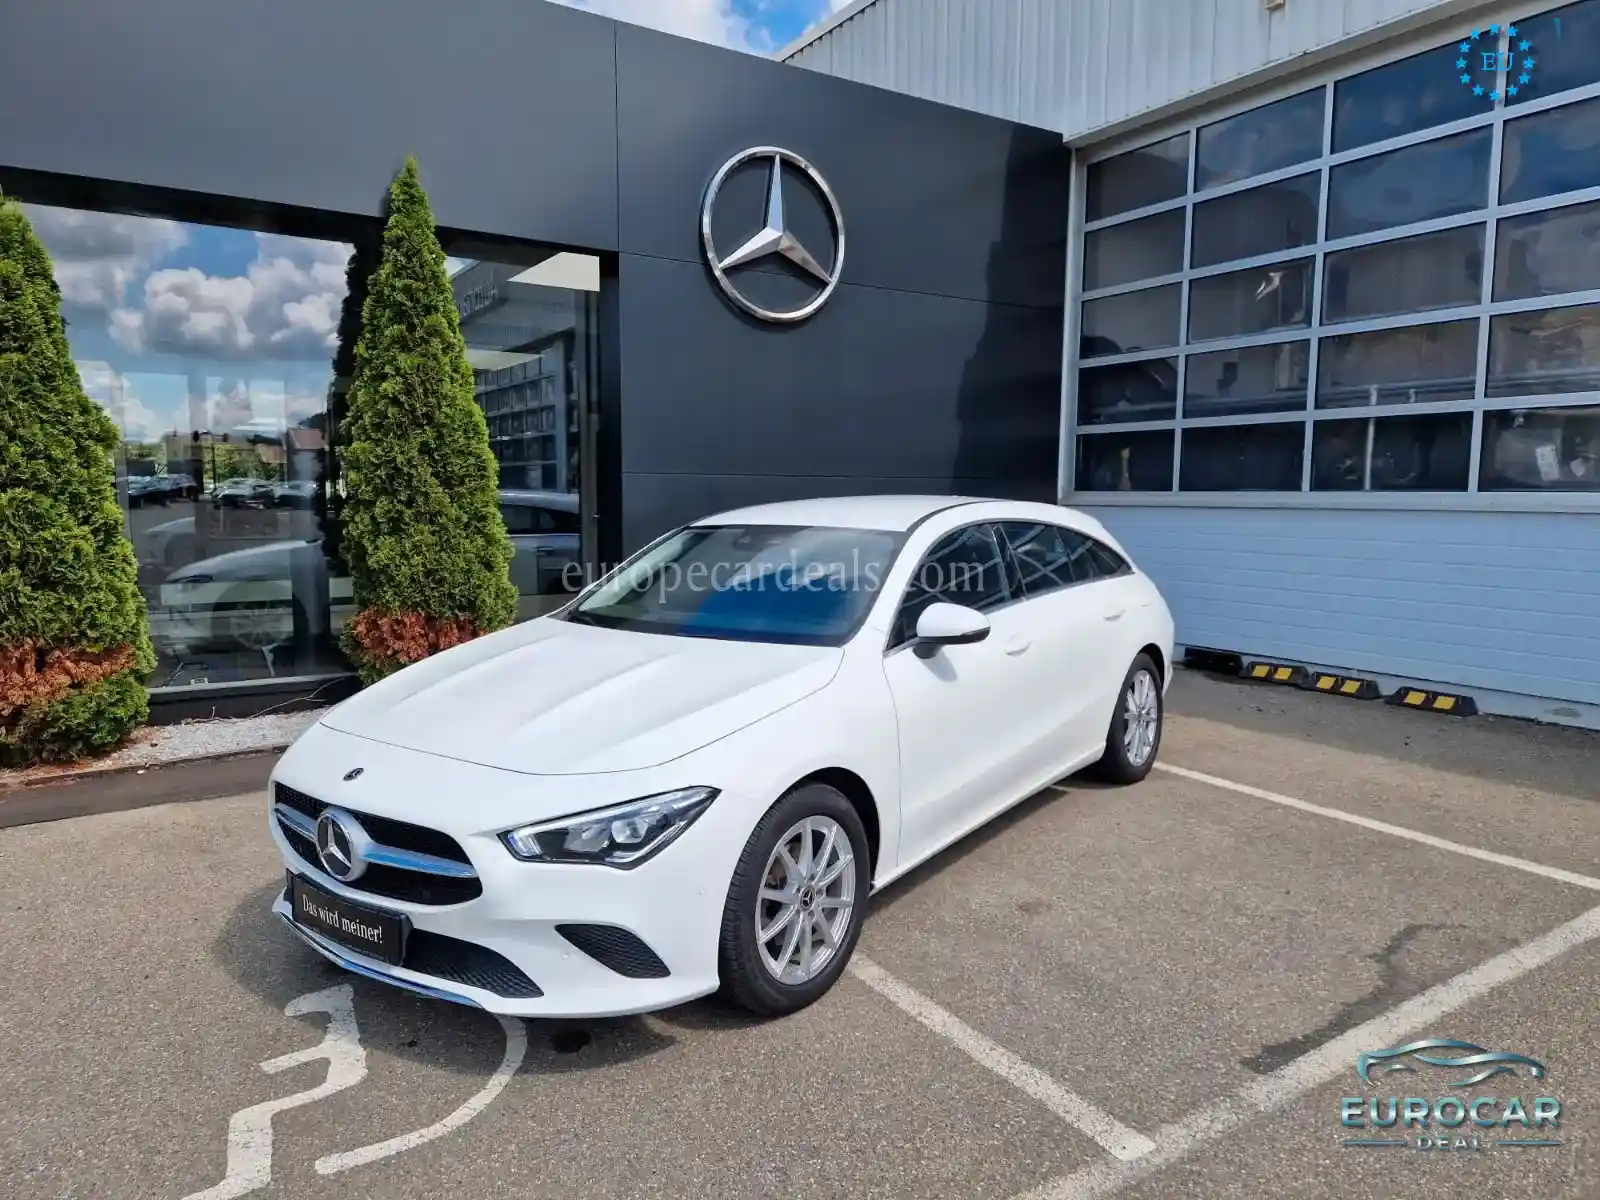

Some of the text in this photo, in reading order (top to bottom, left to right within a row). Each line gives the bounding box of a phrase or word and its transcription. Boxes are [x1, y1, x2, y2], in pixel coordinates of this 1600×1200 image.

[302, 893, 383, 944] Das wird meiner!
